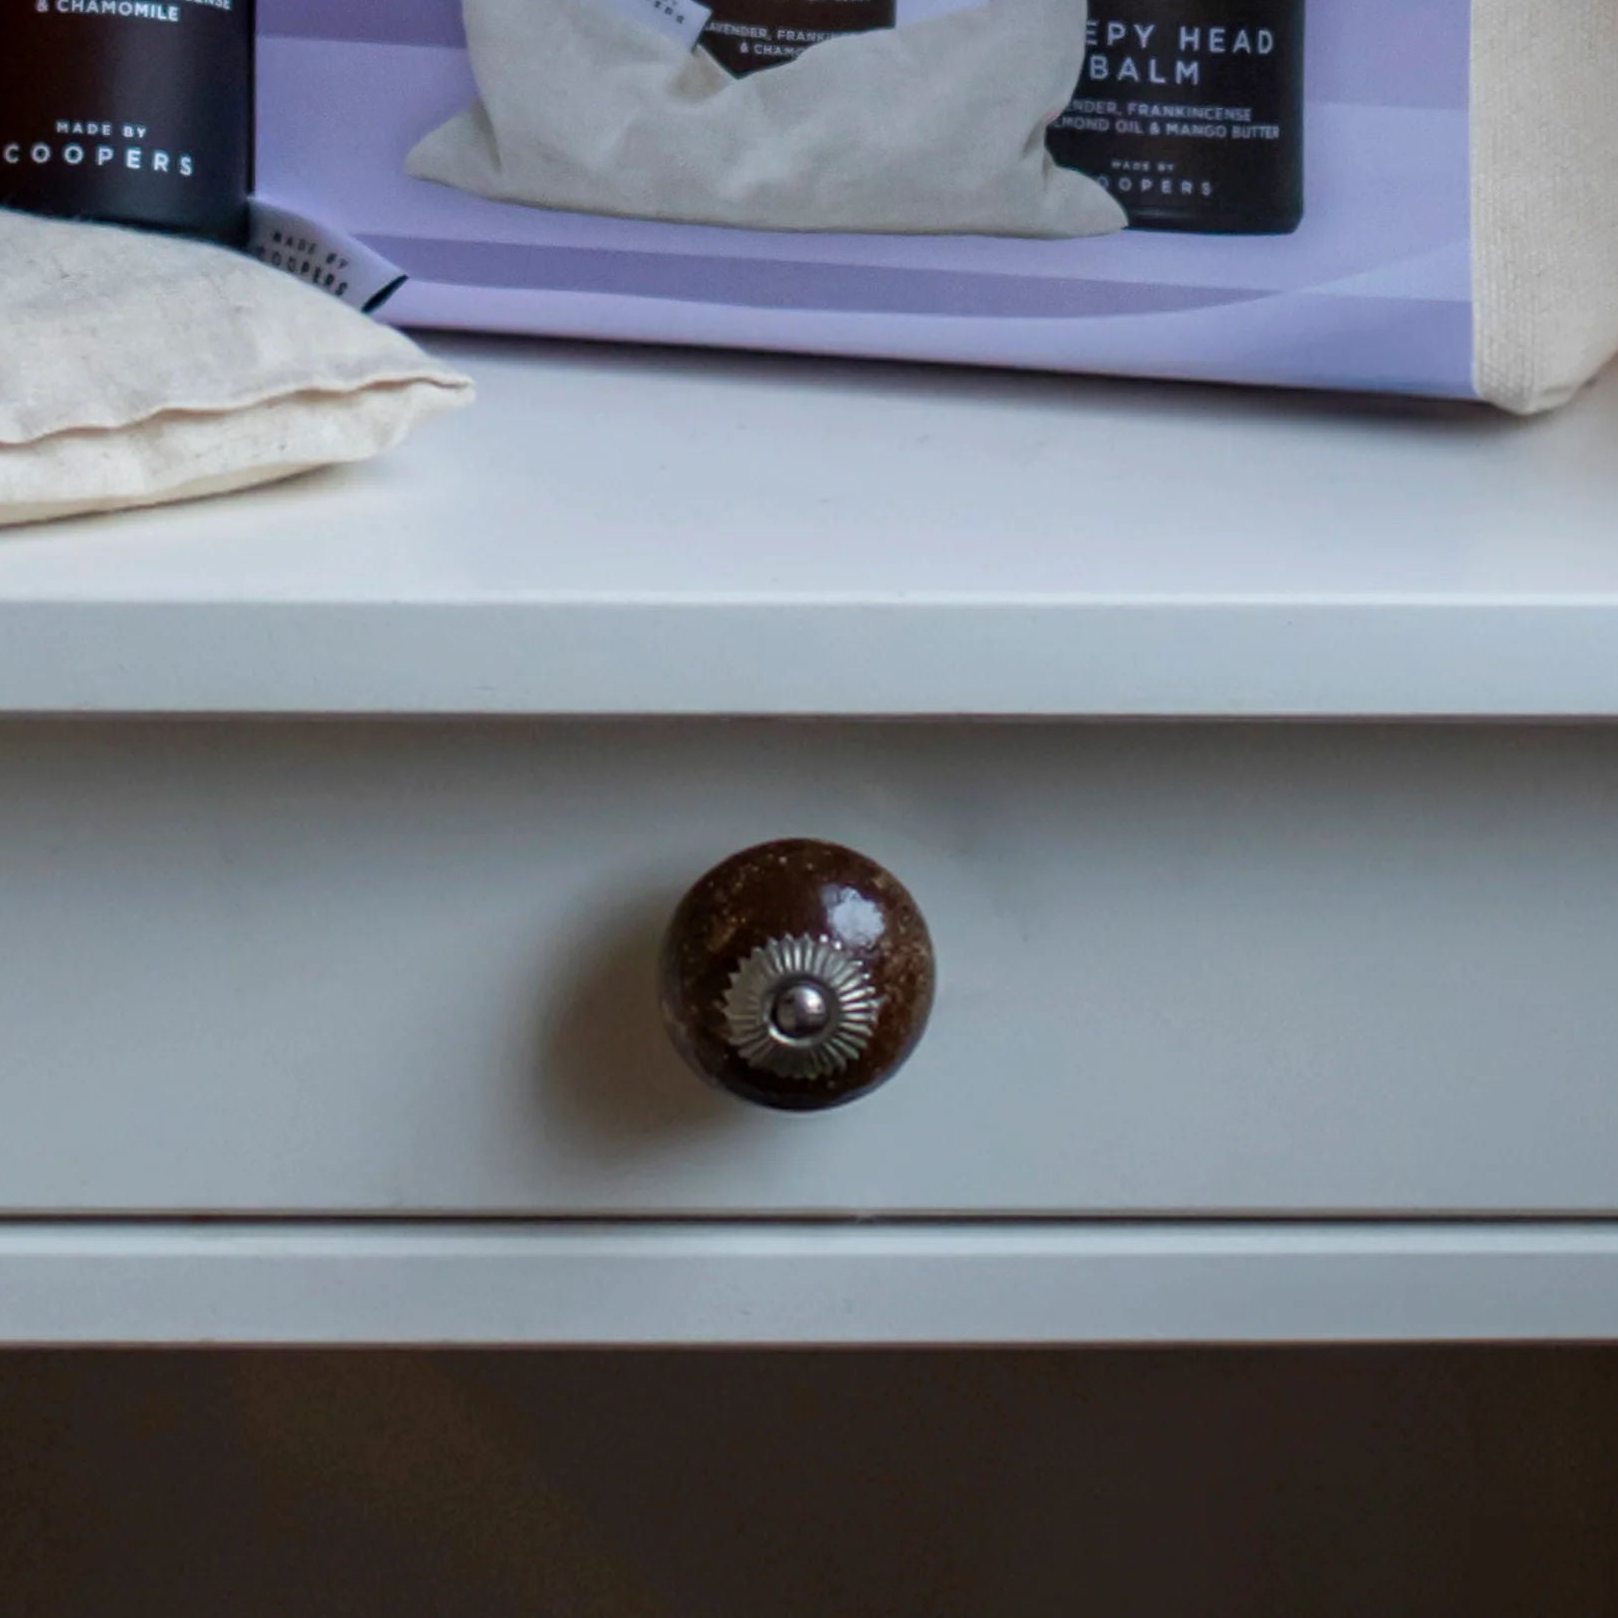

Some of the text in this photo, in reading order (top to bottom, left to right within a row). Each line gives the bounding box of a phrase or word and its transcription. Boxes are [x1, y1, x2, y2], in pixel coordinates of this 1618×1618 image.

[1086, 19, 1274, 54] EPY HEAD
[1089, 55, 1199, 85] BALM
[1127, 102, 1253, 122] FRANKINCENSE
[55, 120, 148, 139] MADE BY
[1231, 125, 1280, 140] BUTTER
[2, 143, 194, 177] COOPERS
[1096, 175, 1213, 196] OOPERS
